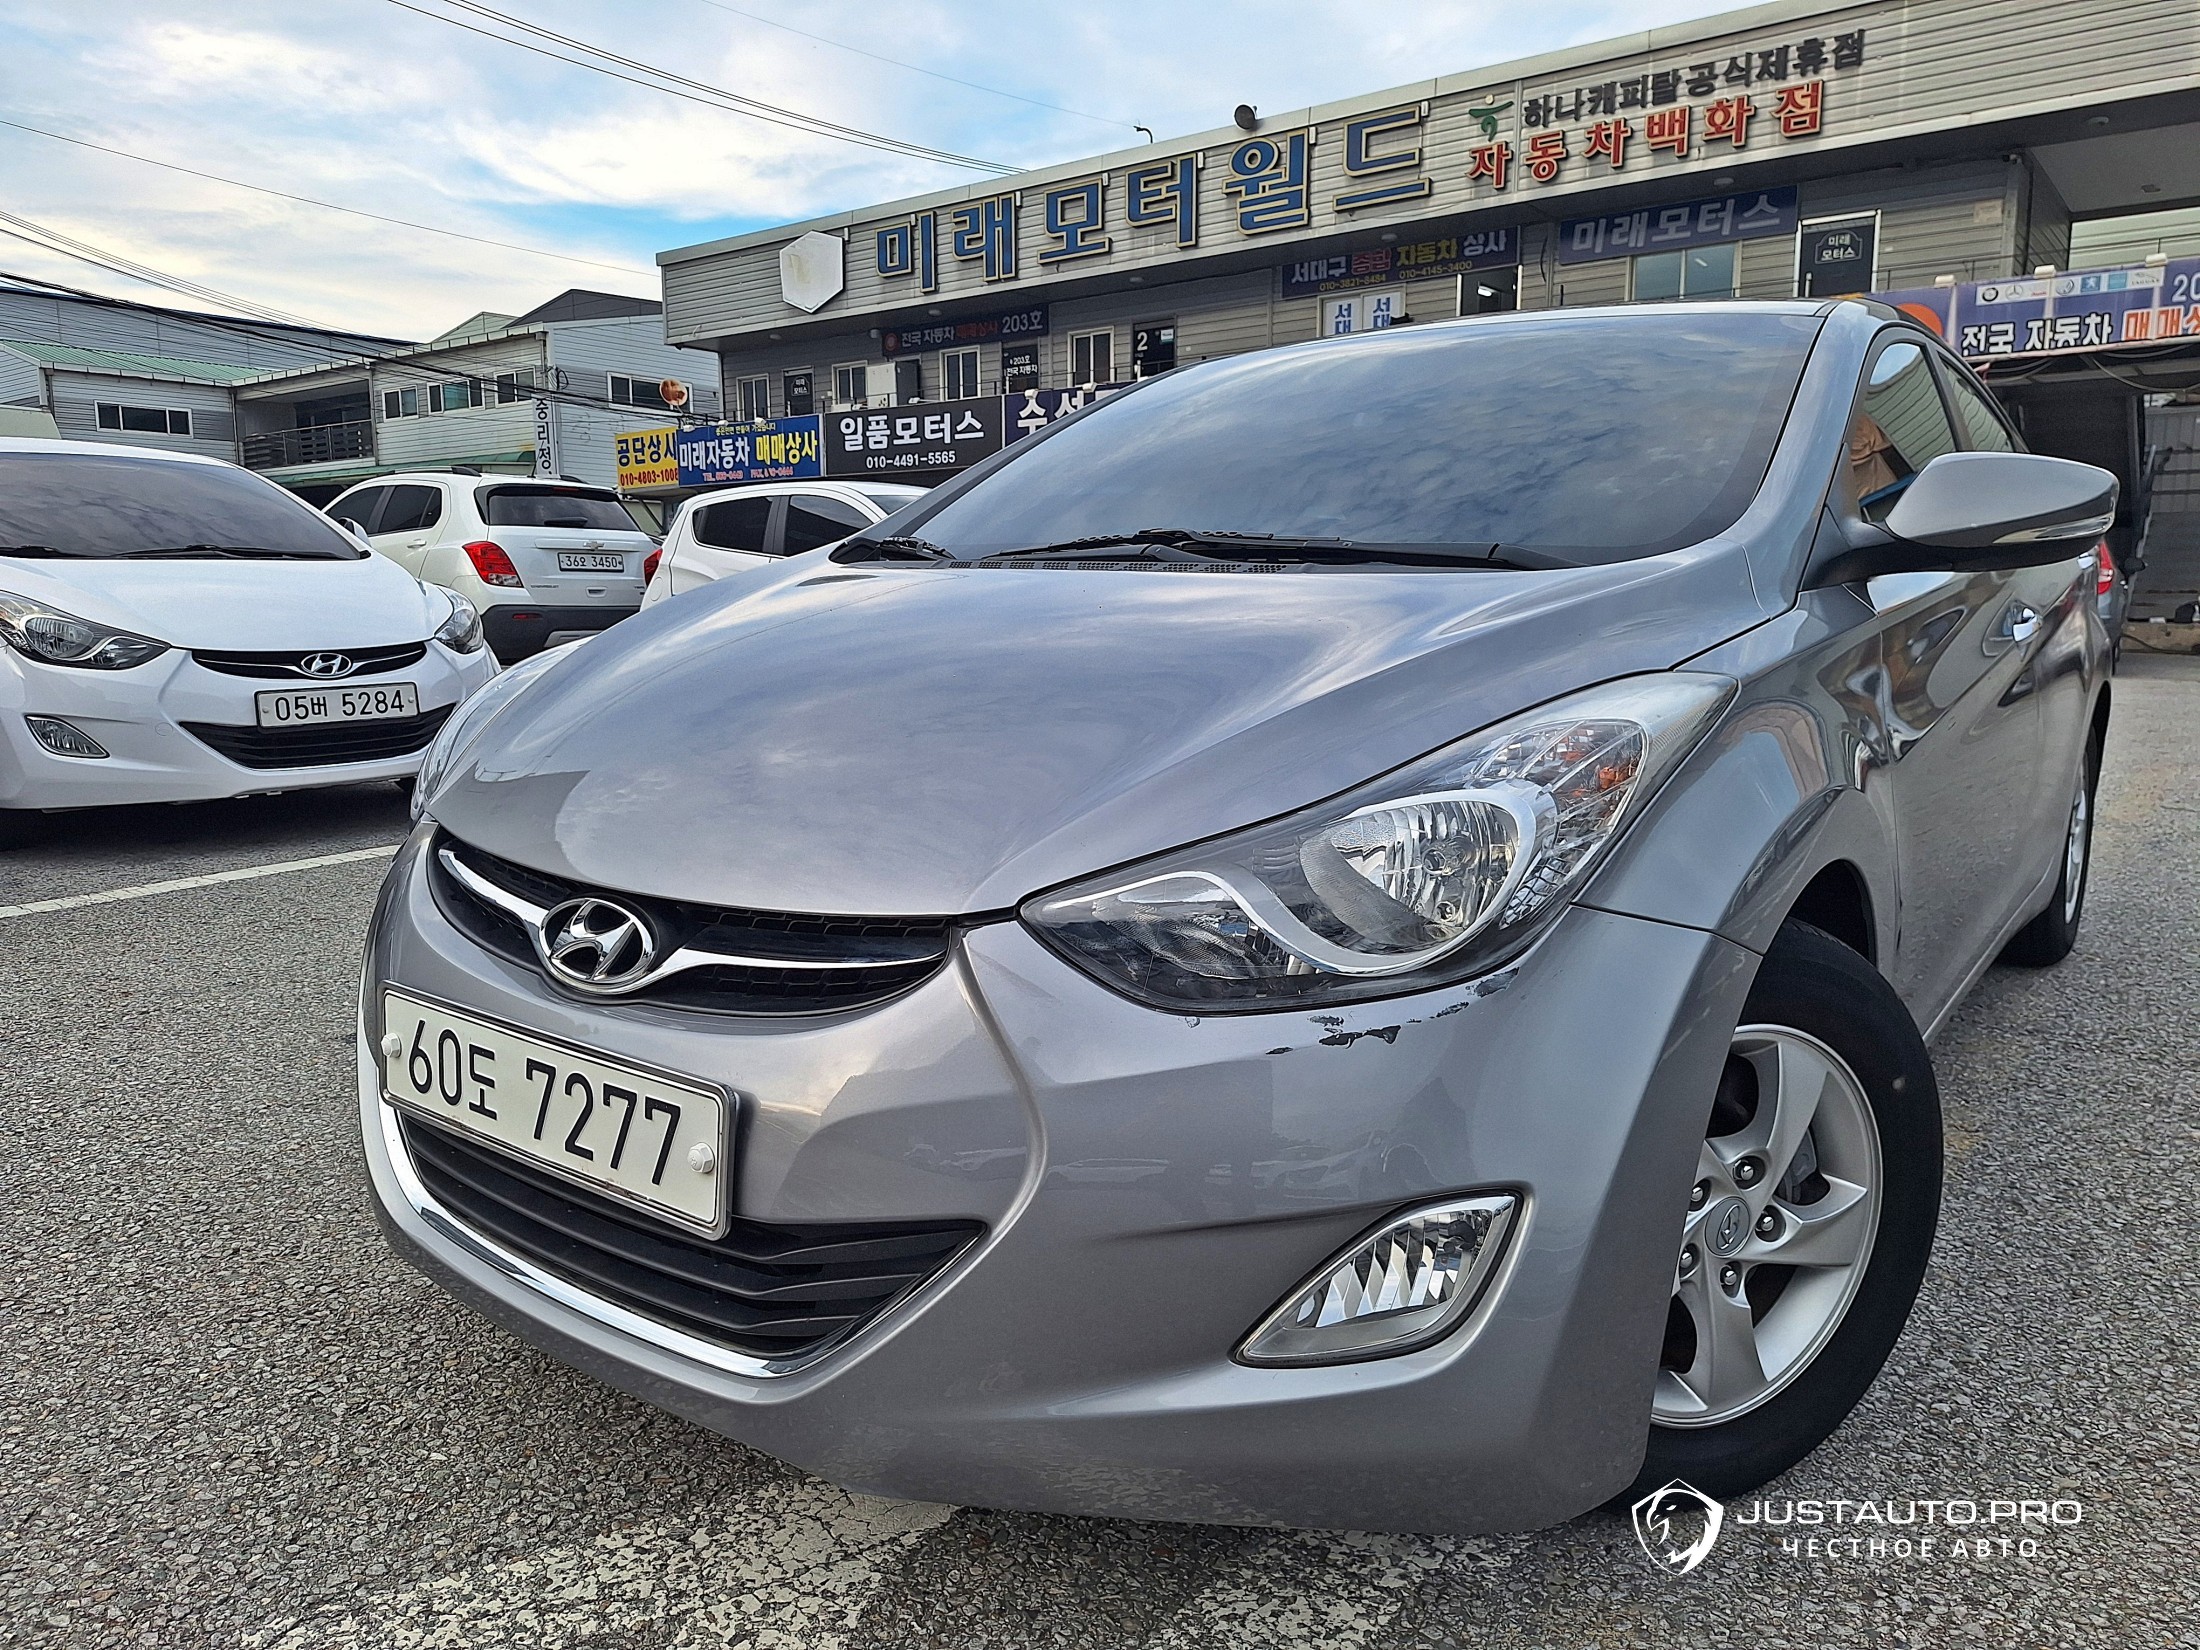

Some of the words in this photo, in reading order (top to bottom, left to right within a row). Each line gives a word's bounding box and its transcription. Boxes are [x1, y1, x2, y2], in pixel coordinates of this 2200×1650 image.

[1291, 255, 1347, 284] 서대구
[1396, 238, 1458, 266] 자동차
[1463, 230, 1507, 257] 상사
[1002, 310, 1044, 334] 203호
[2025, 313, 2113, 350] 자동차
[1137, 331, 1148, 351] 2
[839, 409, 986, 451] 일품모터스
[679, 436, 750, 472] 미래자동차
[755, 430, 817, 466] 매매상사
[866, 450, 956, 469] 010-4491-5565
[591, 556, 617, 568] 3450
[275, 696, 328, 721] 05버
[341, 690, 405, 717] 5284
[408, 1019, 498, 1121] 60도
[525, 1056, 682, 1187] 7277
